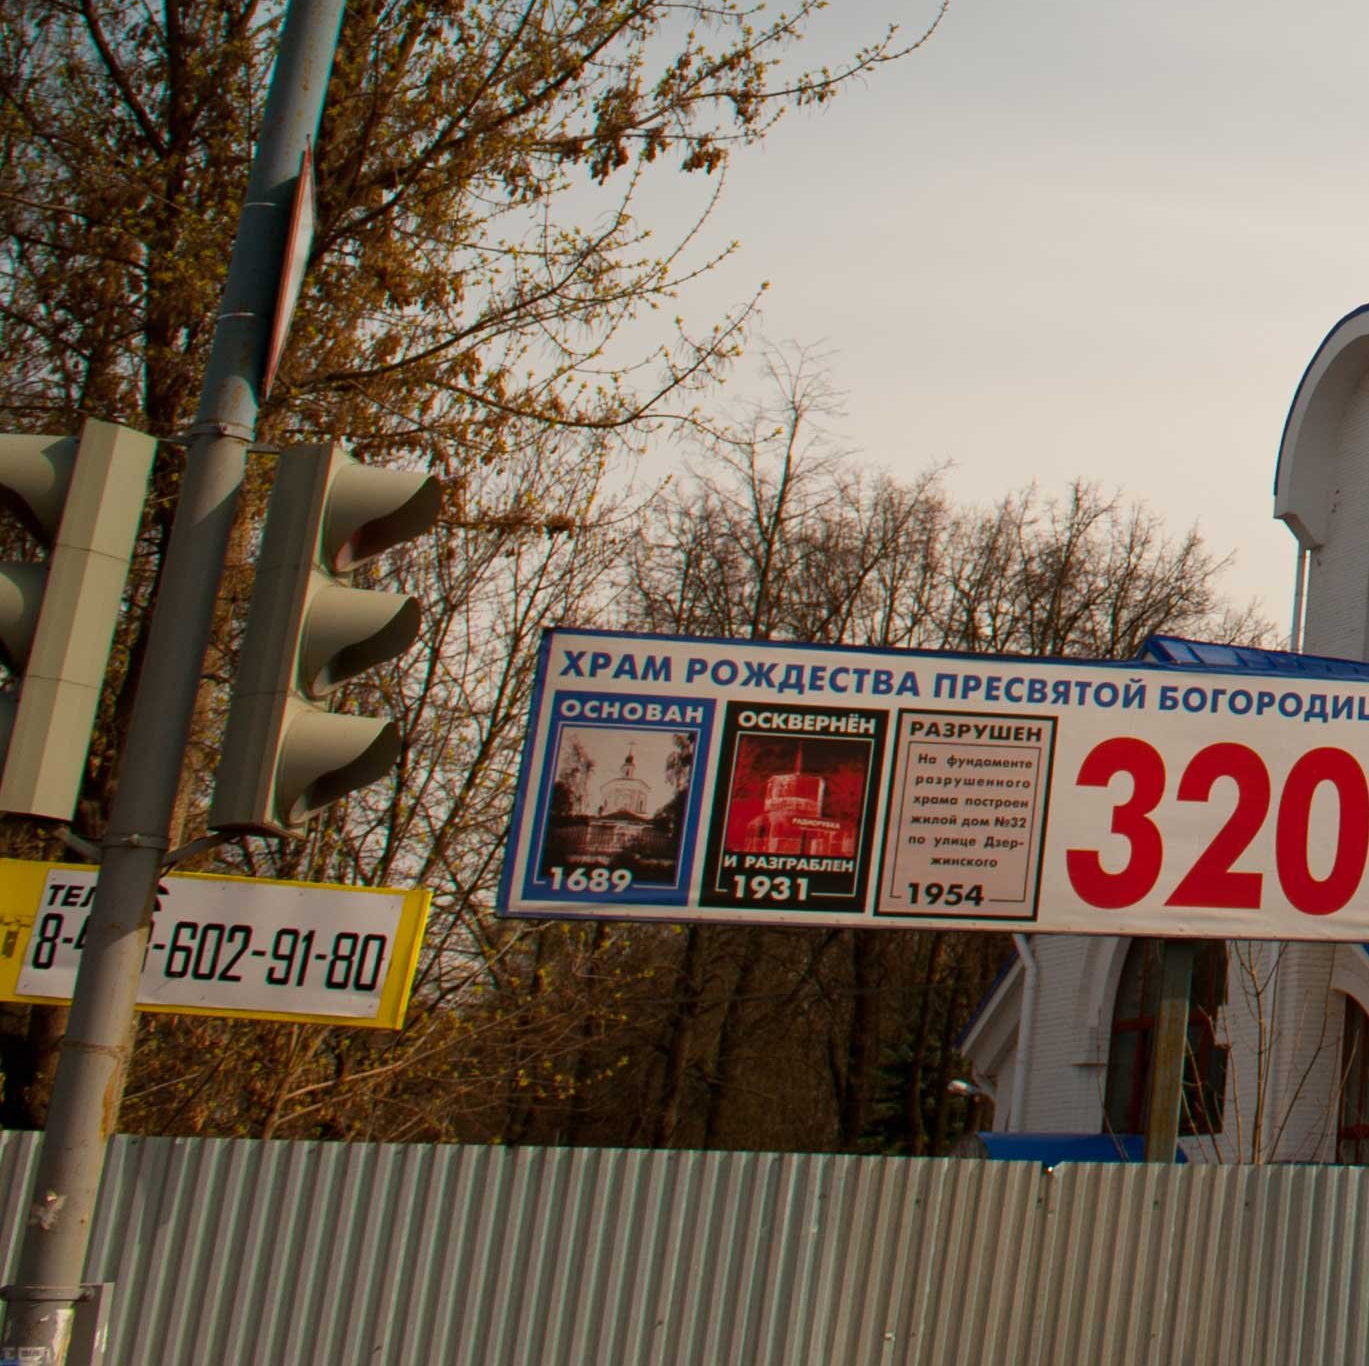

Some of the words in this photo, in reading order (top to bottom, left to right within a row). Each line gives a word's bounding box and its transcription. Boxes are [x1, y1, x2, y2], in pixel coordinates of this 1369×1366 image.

[559, 650, 672, 682] ХРАМ
[685, 657, 920, 697] РОЖДЕСТВА
[934, 672, 1147, 709] ПРЕСВЯТОЙ
[560, 699, 704, 723] ОСНОВАН
[738, 711, 876, 734] ОСКВЕРНЁН
[910, 721, 1043, 742] РАЗРУШЕН
[918, 753, 937, 764] На
[946, 755, 1033, 770] фундаменте
[915, 775, 1031, 789] разрушенного
[913, 796, 958, 806] храма
[965, 798, 1029, 810] построен
[910, 814, 957, 826] жилой
[961, 817, 990, 828] дом
[994, 817, 1027, 828] №32
[908, 835, 925, 844] по
[934, 836, 976, 848] улице
[983, 836, 1024, 850] Дзер-
[724, 854, 739, 868] И
[745, 856, 855, 873] РАЗГРАБЛЕН
[930, 857, 998, 868] жинского
[550, 866, 633, 893] 1689
[733, 875, 810, 901] 1931
[908, 882, 985, 907] 1954
